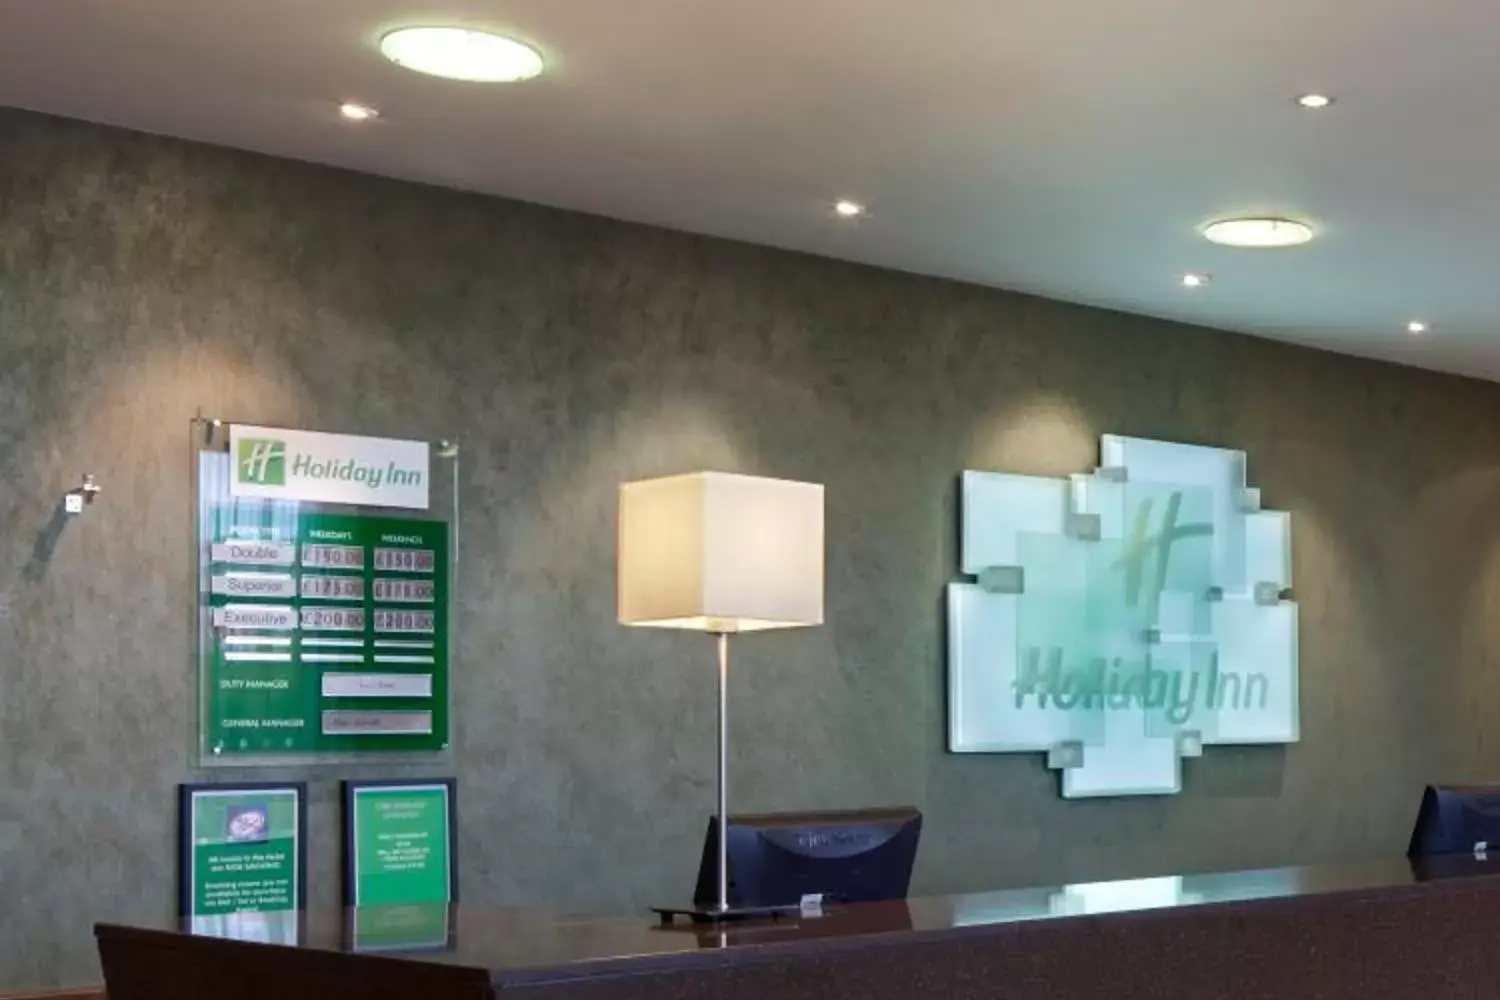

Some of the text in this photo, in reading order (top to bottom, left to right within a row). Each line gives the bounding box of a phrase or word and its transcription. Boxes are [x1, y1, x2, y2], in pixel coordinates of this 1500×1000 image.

[291, 454, 422, 488] Holiday Inn
[230, 545, 279, 560] Double
[226, 577, 284, 594] Superior
[223, 611, 288, 626] Executive
[1013, 646, 1269, 724] Holiday Inn
